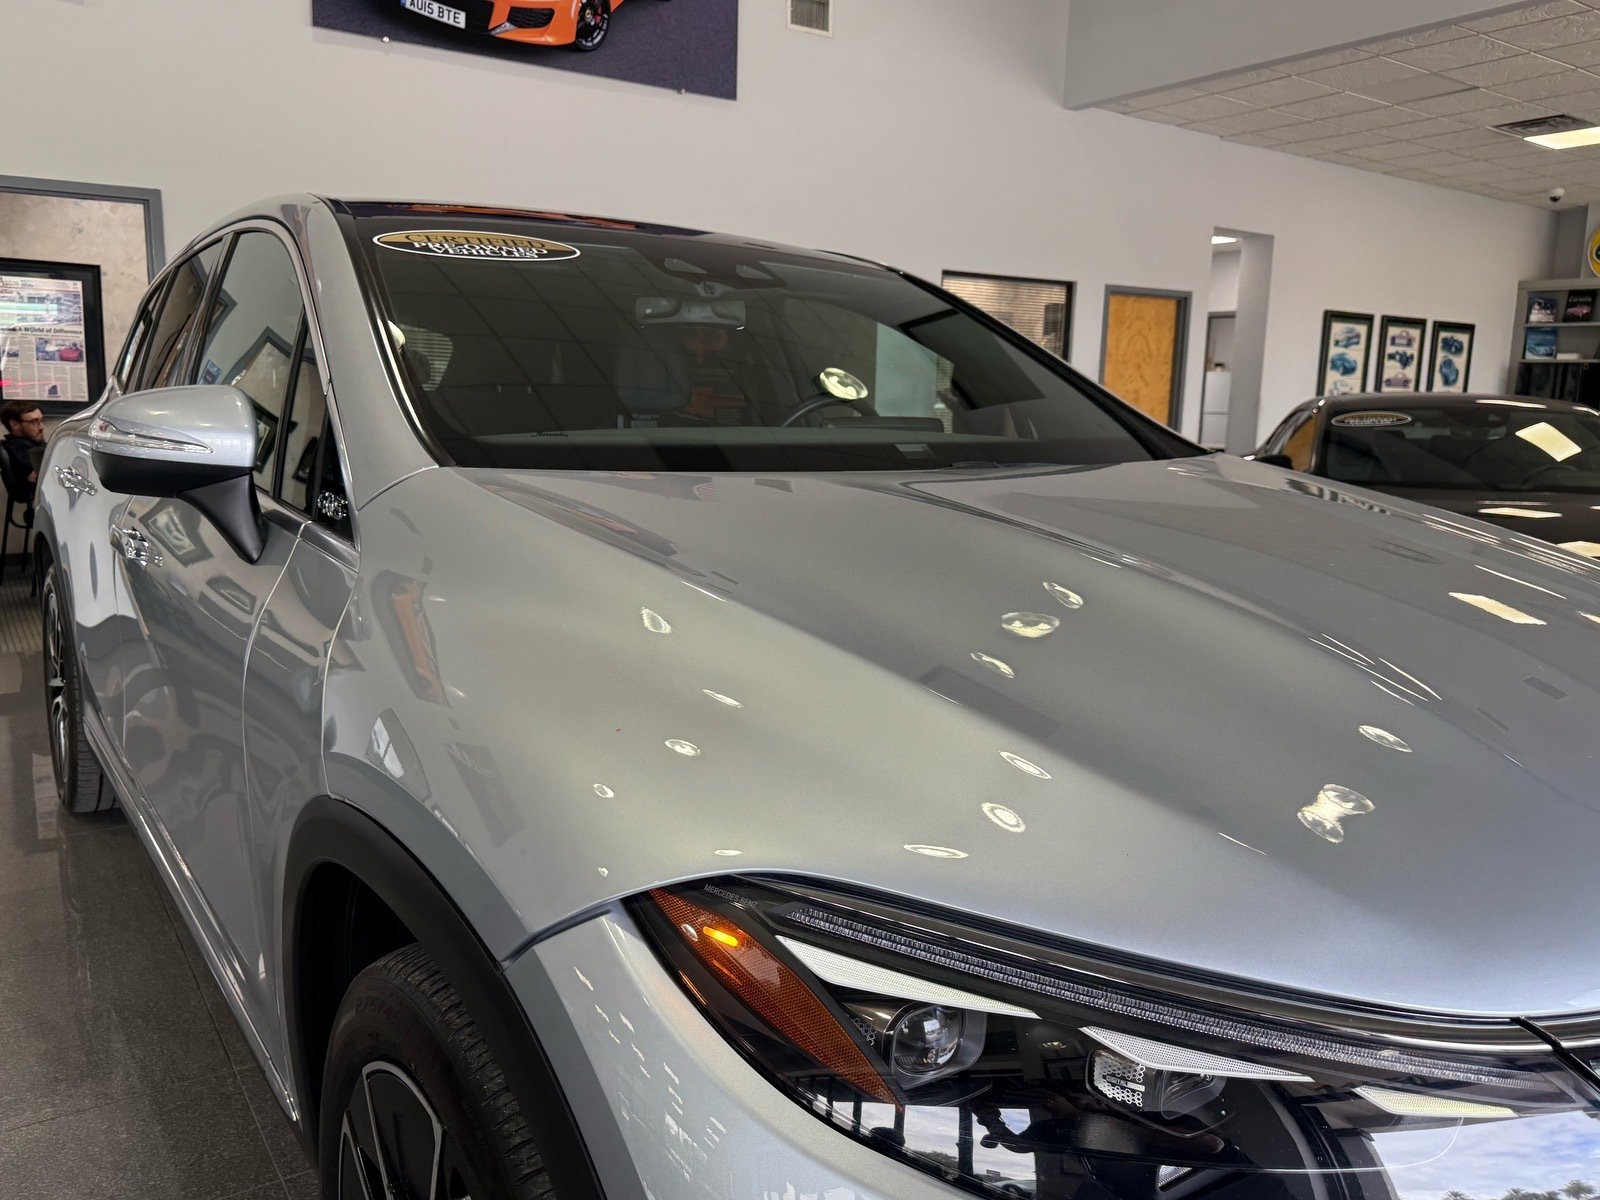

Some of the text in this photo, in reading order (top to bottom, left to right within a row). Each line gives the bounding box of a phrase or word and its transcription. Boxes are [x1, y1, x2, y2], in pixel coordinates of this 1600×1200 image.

[437, 6, 461, 24] BTE
[405, 234, 545, 248] CERTIFIED
[413, 241, 548, 255] PRE-OWNED
[431, 246, 538, 258] VEHICLES
[704, 883, 758, 908] MERCEDES-BENZ
